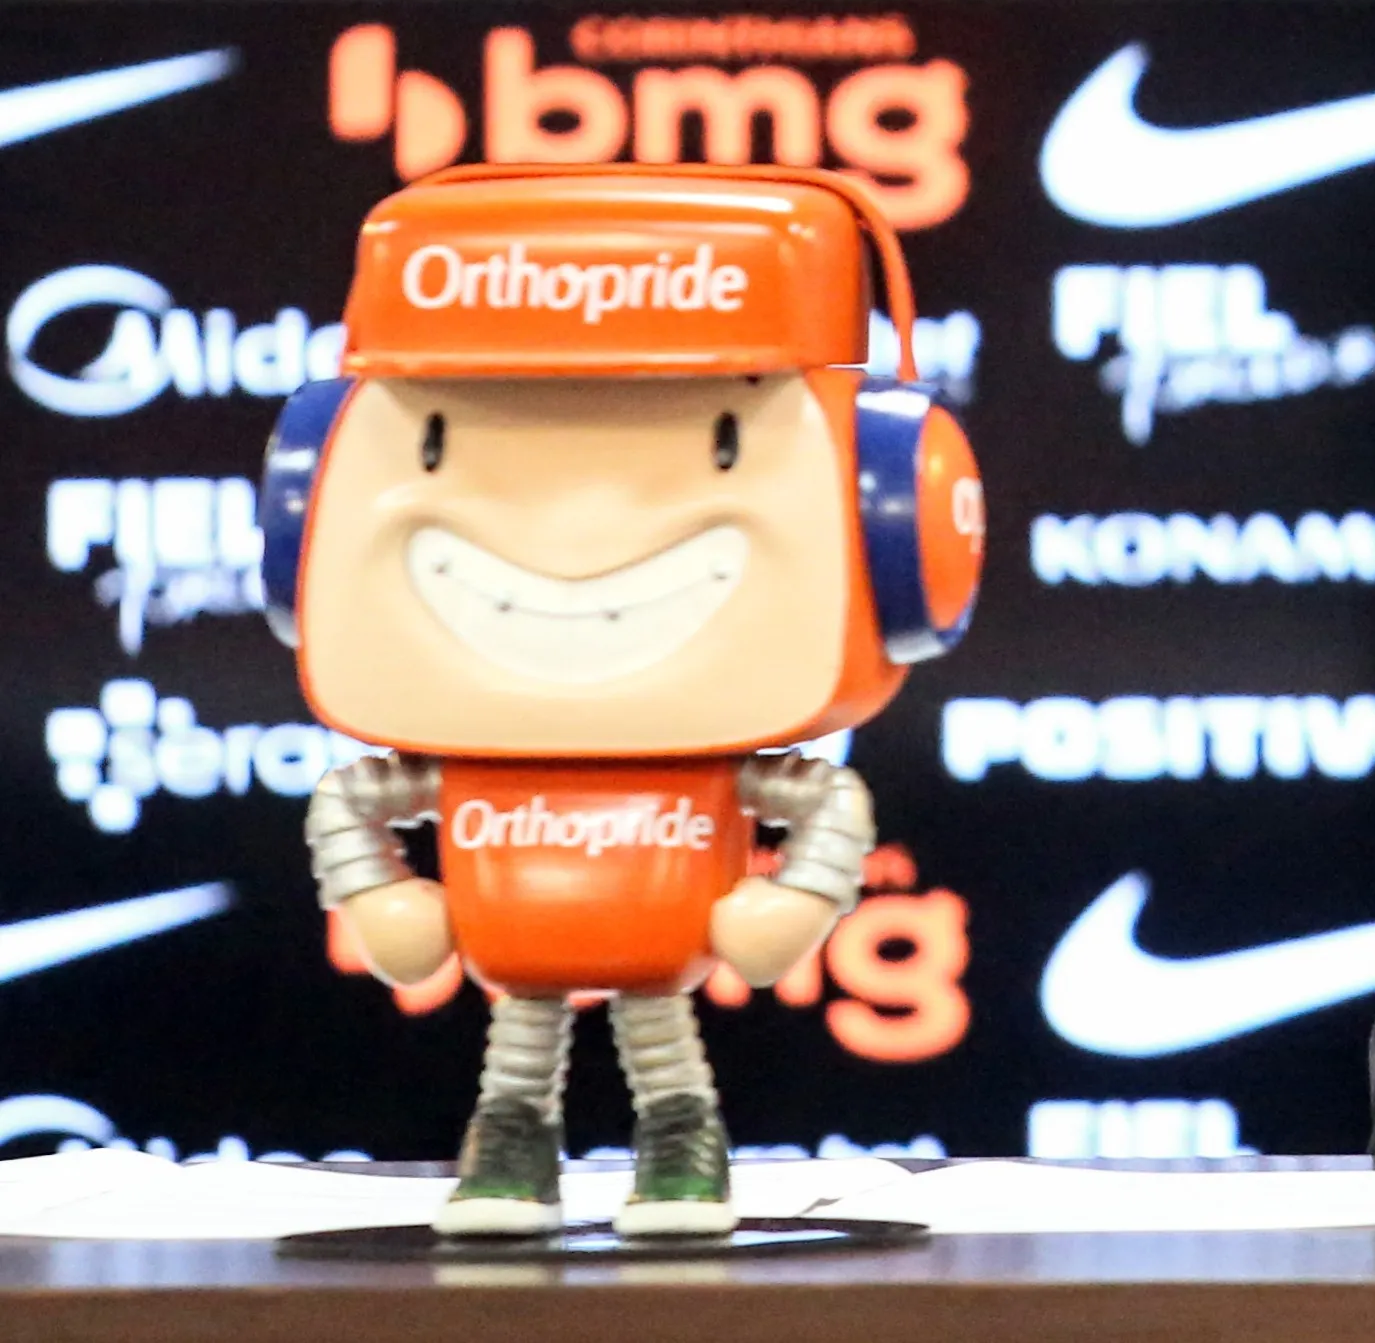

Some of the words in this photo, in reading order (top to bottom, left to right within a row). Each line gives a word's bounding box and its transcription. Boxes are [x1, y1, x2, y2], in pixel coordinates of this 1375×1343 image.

[484, 26, 972, 231] bmg
[402, 243, 748, 323] Orthopride
[78, 306, 347, 398] Mide
[107, 722, 390, 798] sera
[452, 797, 716, 855] Orthopride
